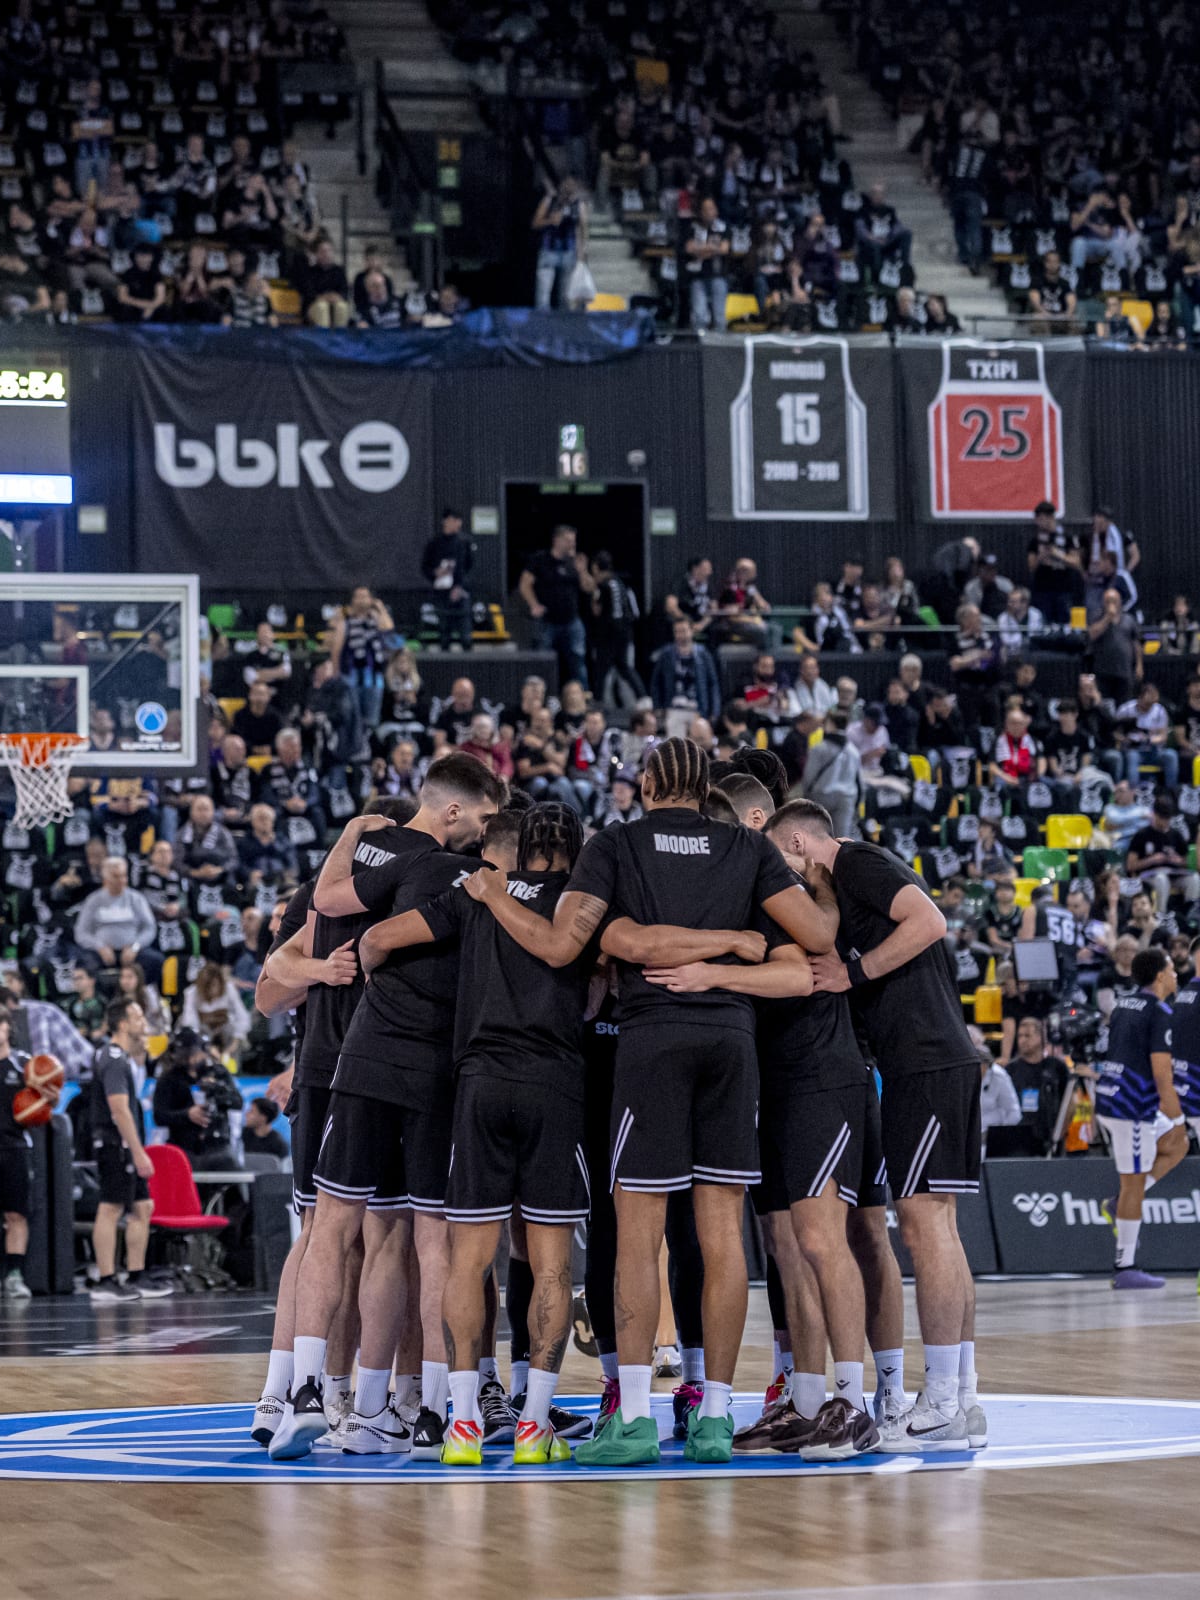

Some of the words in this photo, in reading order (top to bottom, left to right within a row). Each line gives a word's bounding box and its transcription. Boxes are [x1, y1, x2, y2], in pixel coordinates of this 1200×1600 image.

[967, 359, 1019, 380] TXIPI
[776, 392, 821, 445] 15
[960, 405, 1031, 462] 25
[153, 422, 335, 489] bbk
[559, 452, 586, 476] 16
[653, 833, 711, 855] MOORE
